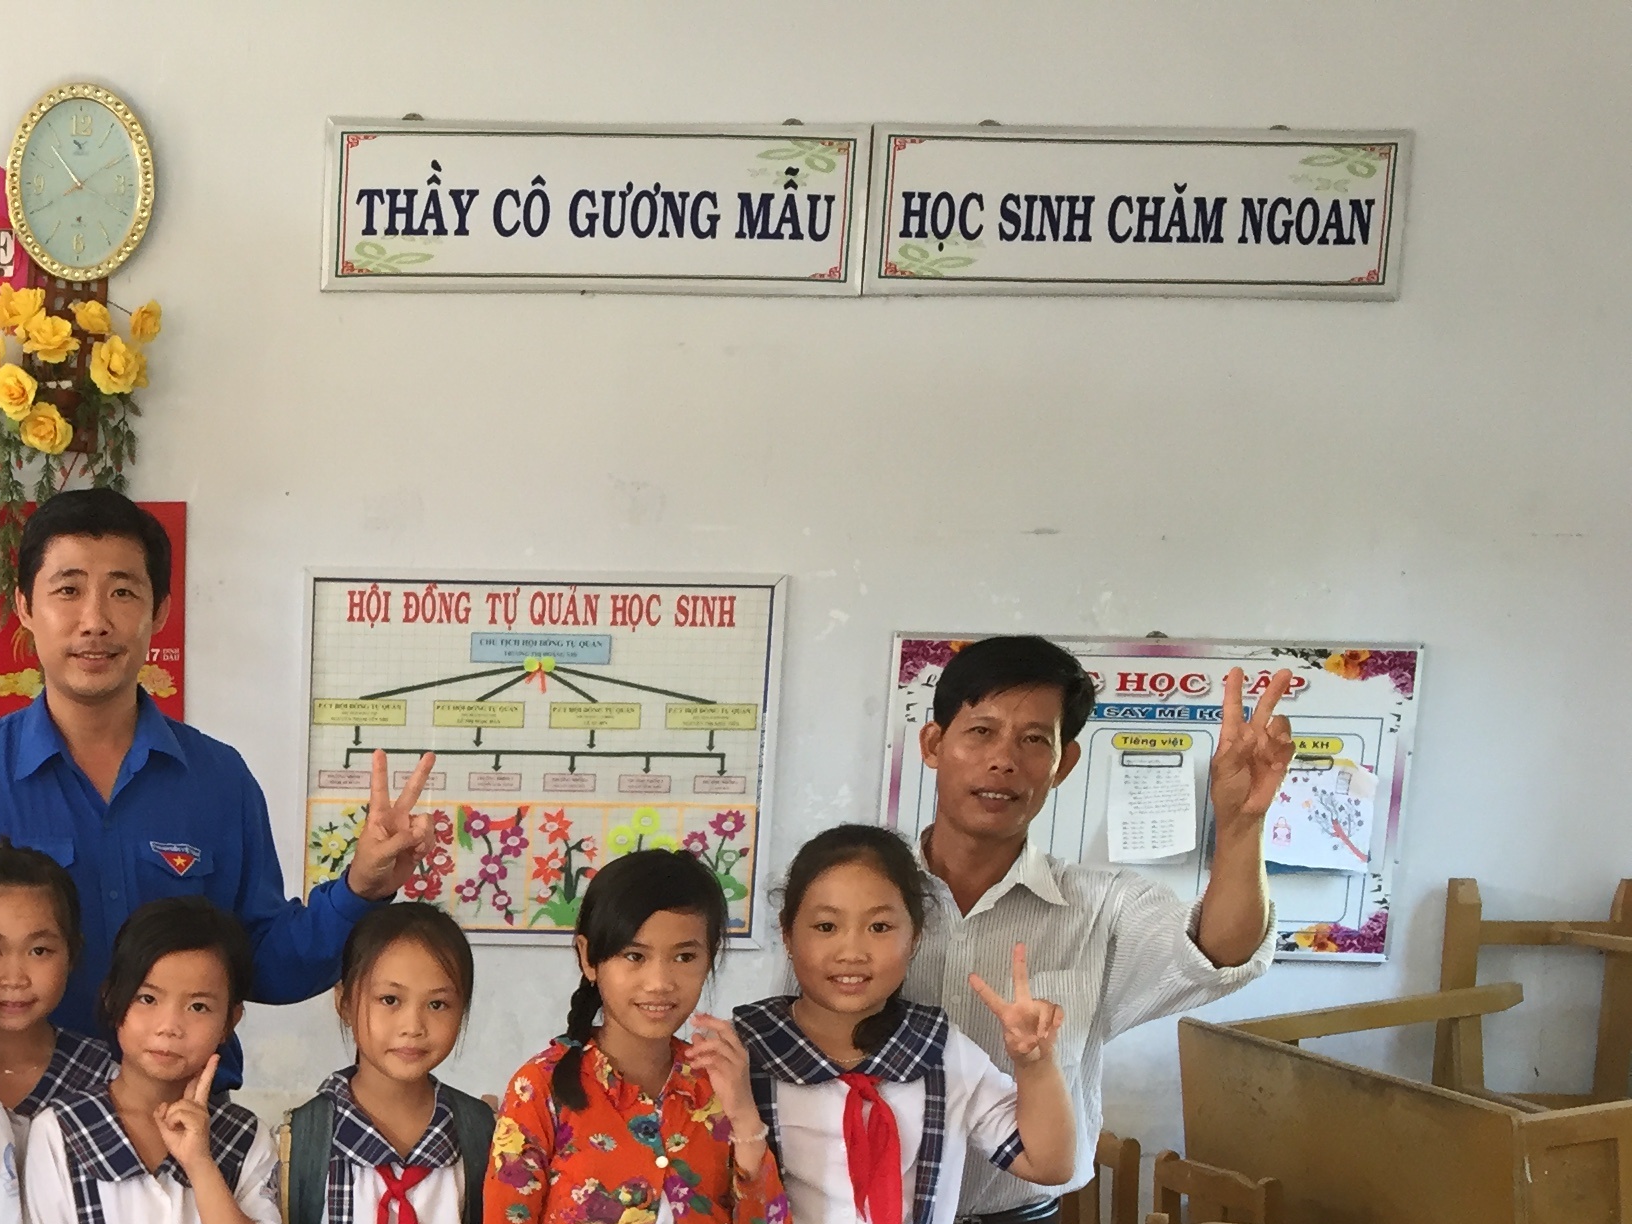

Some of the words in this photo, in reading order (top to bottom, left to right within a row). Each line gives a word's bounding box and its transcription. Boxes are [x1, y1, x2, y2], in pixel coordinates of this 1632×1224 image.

[71, 114, 93, 136] 12
[356, 159, 479, 237] THẦY
[492, 175, 551, 238] CÔ
[568, 180, 721, 240] GƯƠNG
[735, 166, 836, 242] MẪU
[899, 190, 985, 252] HỌC
[998, 194, 1095, 242] SINH
[1107, 182, 1227, 244] CHĂM
[1237, 197, 1376, 246] NGOAN
[73, 233, 85, 253] 6
[347, 583, 391, 629] HỘI
[402, 582, 471, 625] ĐỒNG
[486, 587, 521, 631] TỰ
[530, 585, 600, 626] QUẢN
[610, 593, 662, 633] HỌC
[674, 595, 736, 627] SINH
[1118, 672, 1207, 697] HỌC
[1104, 707, 1151, 718] SAY
